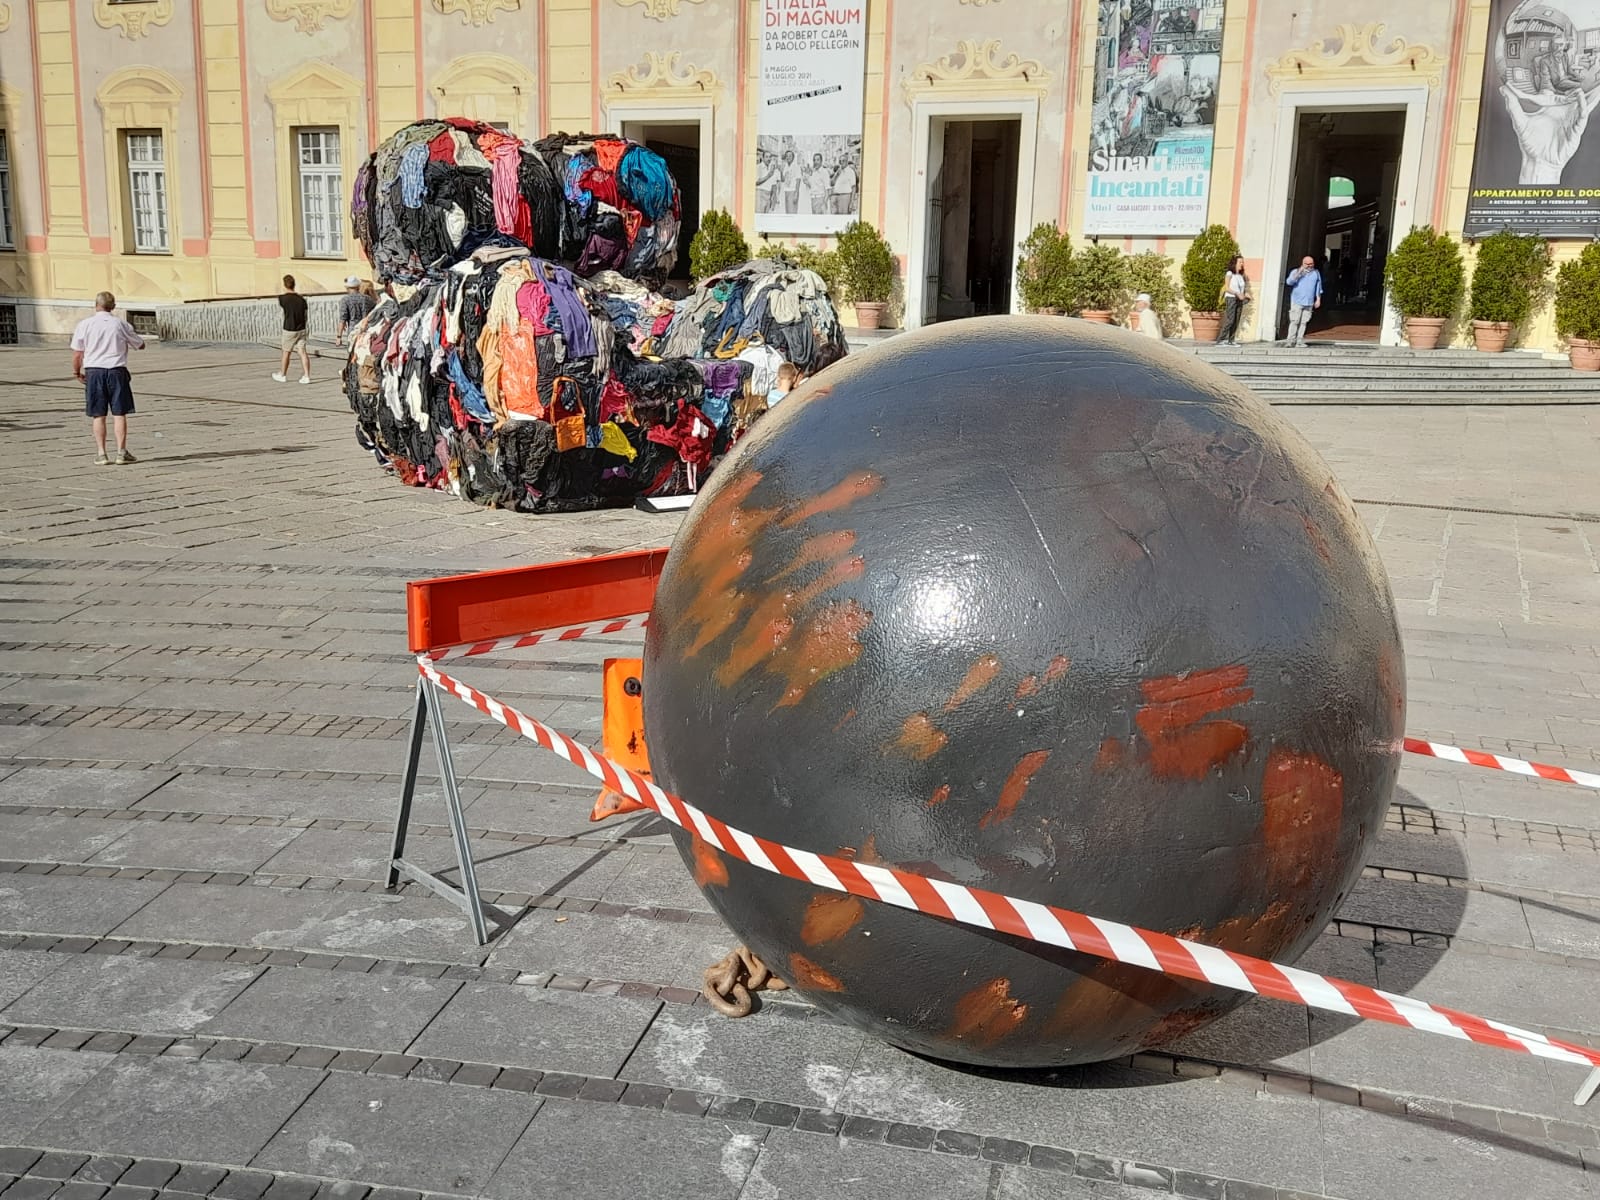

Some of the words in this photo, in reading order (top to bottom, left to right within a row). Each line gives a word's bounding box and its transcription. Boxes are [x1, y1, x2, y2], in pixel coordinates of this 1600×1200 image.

[766, 0, 827, 9] LITALIA
[766, 12, 780, 27] DI
[786, 9, 860, 26] MAGNUM
[766, 31, 778, 40] DA
[781, 30, 817, 40] ROBERT
[821, 29, 848, 39] CAPA
[766, 42, 772, 50] A
[775, 41, 806, 50] PAOLO
[810, 40, 859, 50] PELLEGRIN
[1091, 148, 1171, 172] Sipari
[1091, 173, 1204, 197] Incantati
[1473, 189, 1553, 197] APPARTAMENTO
[1556, 189, 1575, 197] DEL
[1578, 189, 1600, 197] DOG
